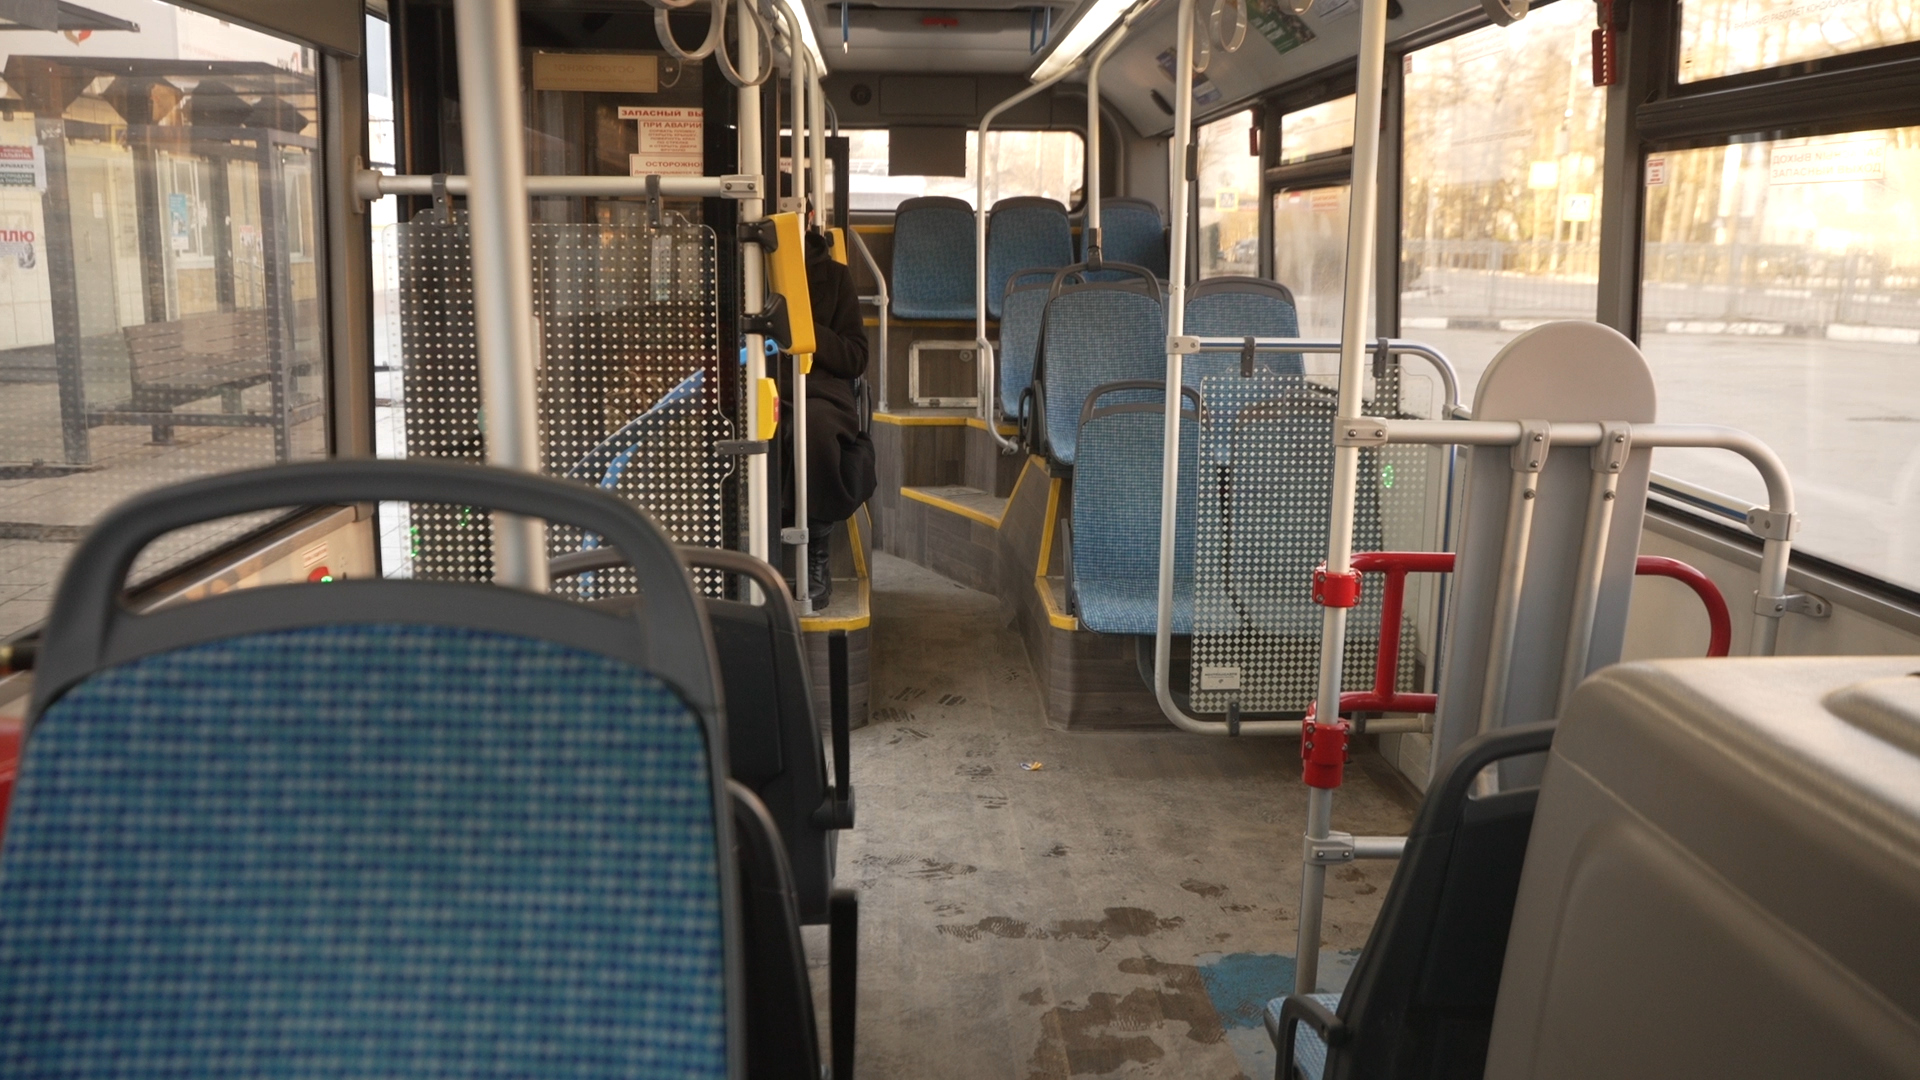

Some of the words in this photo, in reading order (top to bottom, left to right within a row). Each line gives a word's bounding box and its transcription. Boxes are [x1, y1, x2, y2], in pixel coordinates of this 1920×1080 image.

[1771, 6, 1804, 22] РАБОТАЕТ
[621, 109, 682, 117] ЗАПАСНЫЙ
[1837, 163, 1881, 175] ВЫХОД
